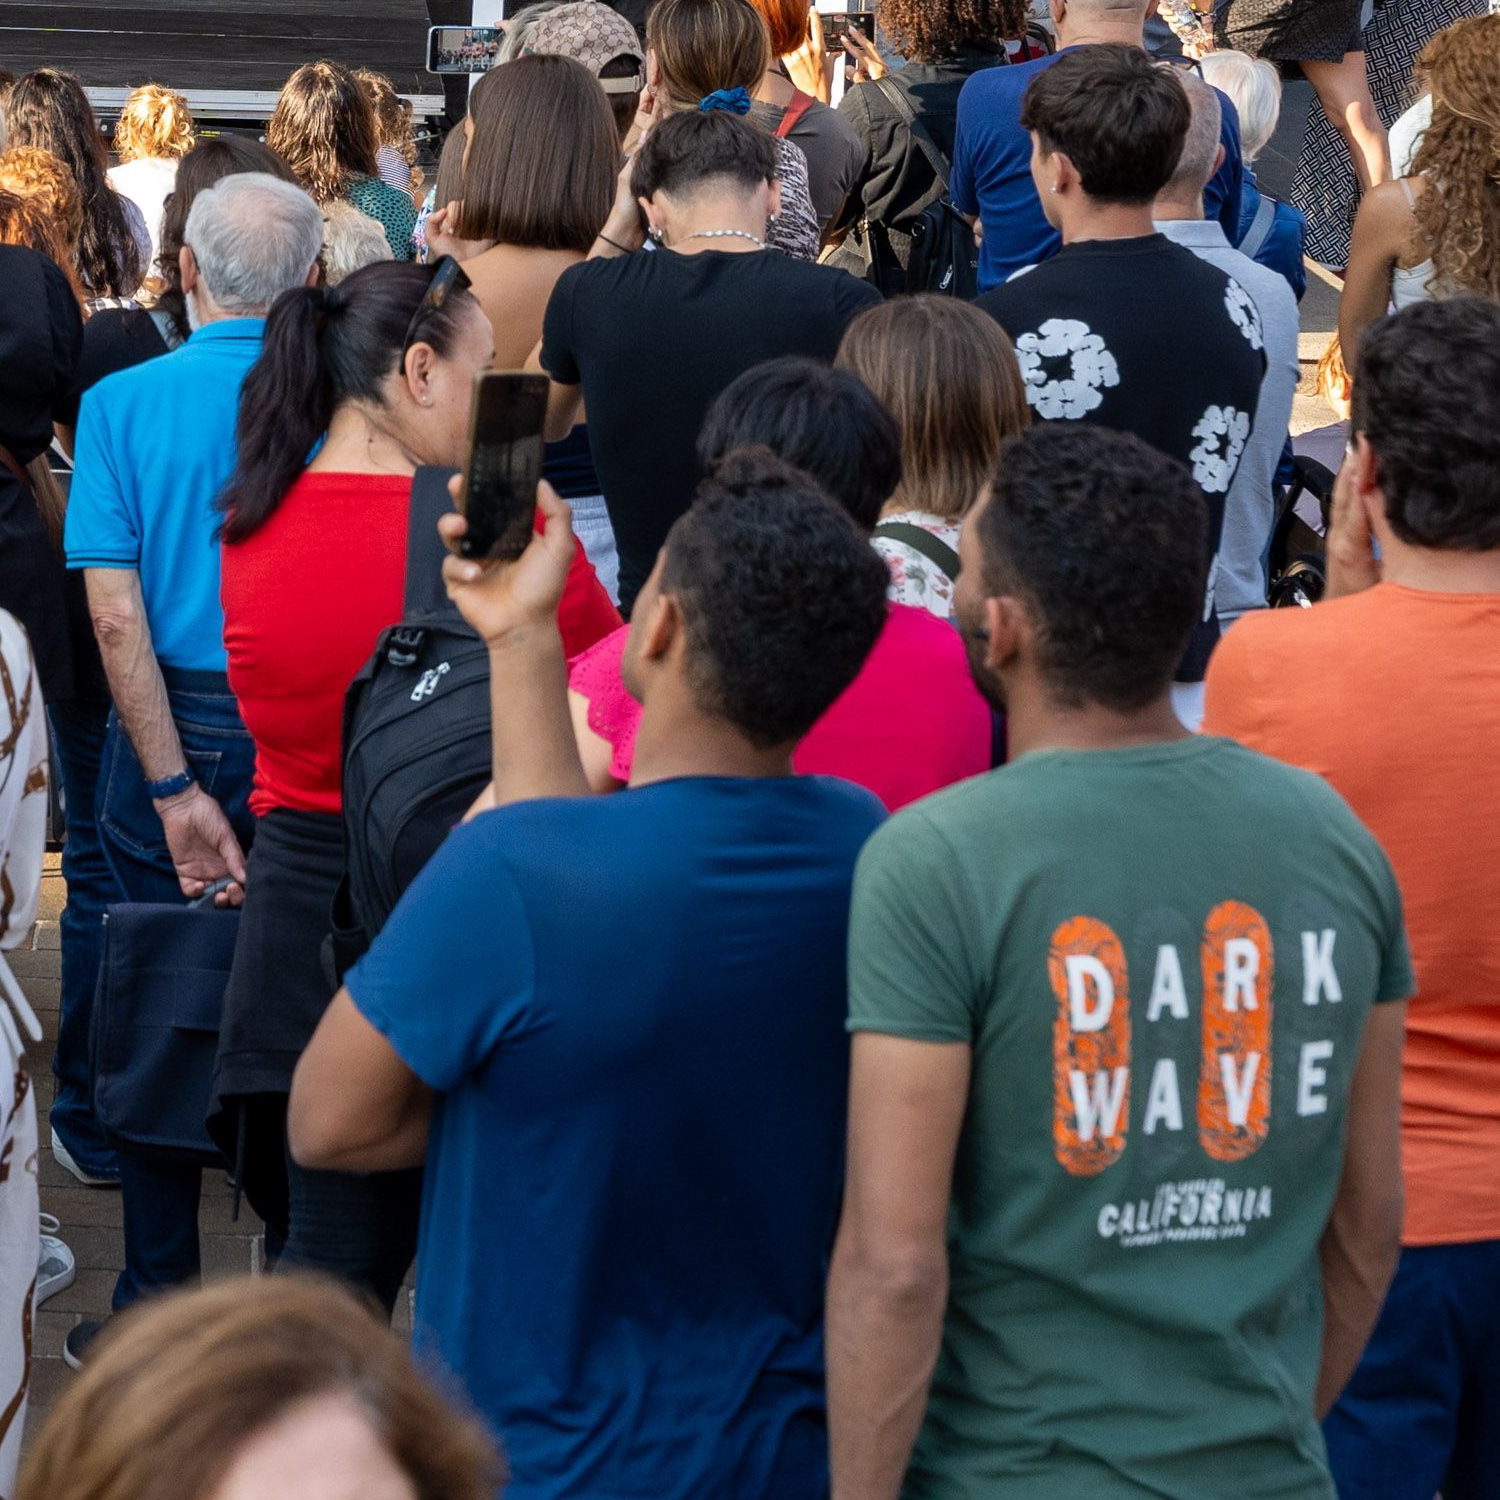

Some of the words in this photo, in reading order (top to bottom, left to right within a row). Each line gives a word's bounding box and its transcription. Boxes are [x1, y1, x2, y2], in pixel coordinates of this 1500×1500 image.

[1064, 928, 1343, 1033] DARK
[1070, 1040, 1334, 1143] WAVE
[1097, 1184, 1272, 1238] CALIFORNIA
